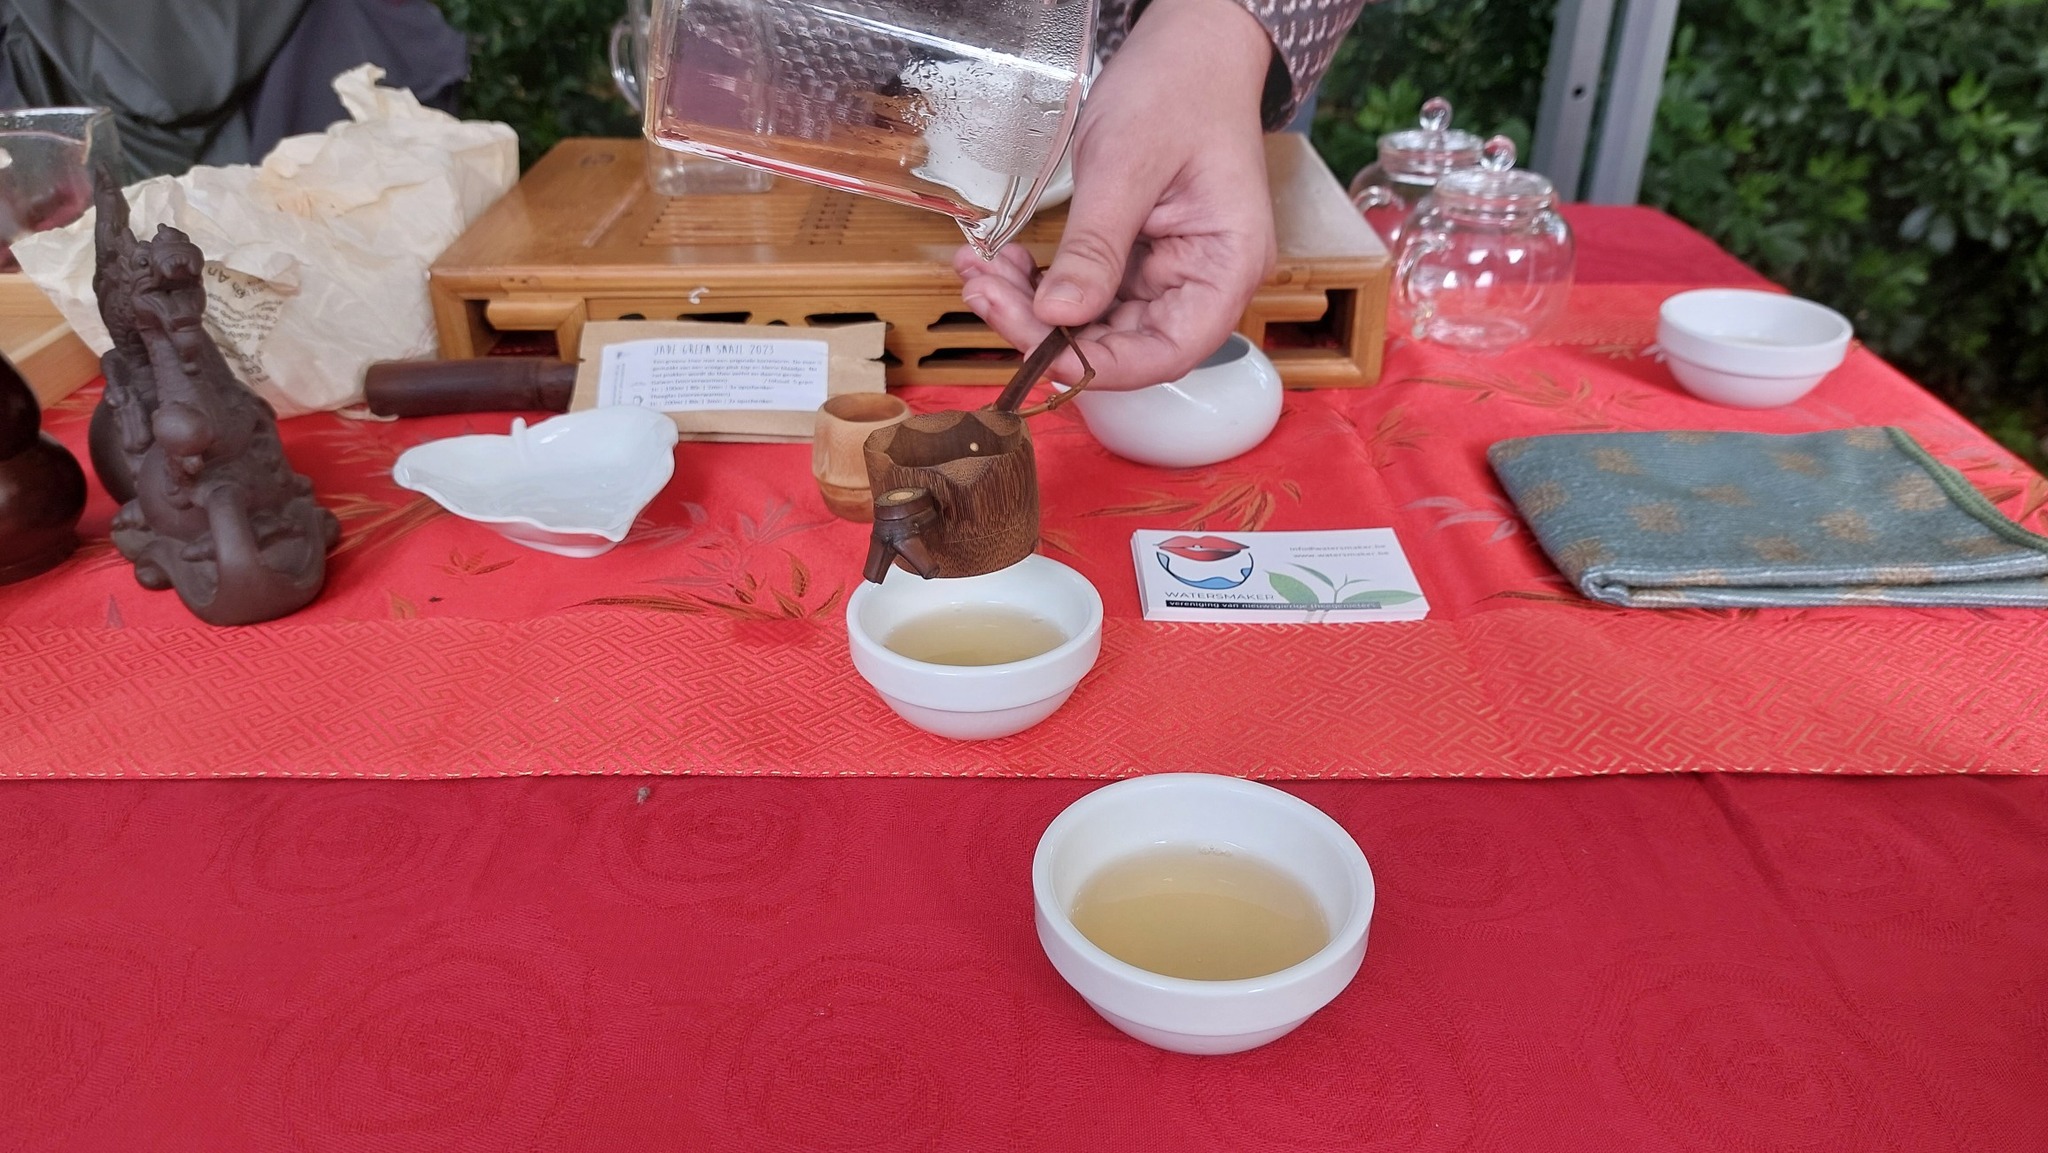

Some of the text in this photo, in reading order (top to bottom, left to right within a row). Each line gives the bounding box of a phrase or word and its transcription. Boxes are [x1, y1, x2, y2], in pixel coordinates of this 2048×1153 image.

[682, 343, 711, 355] GREEN
[750, 344, 775, 355] 2023
[1164, 592, 1275, 600] WATERSMAKER
